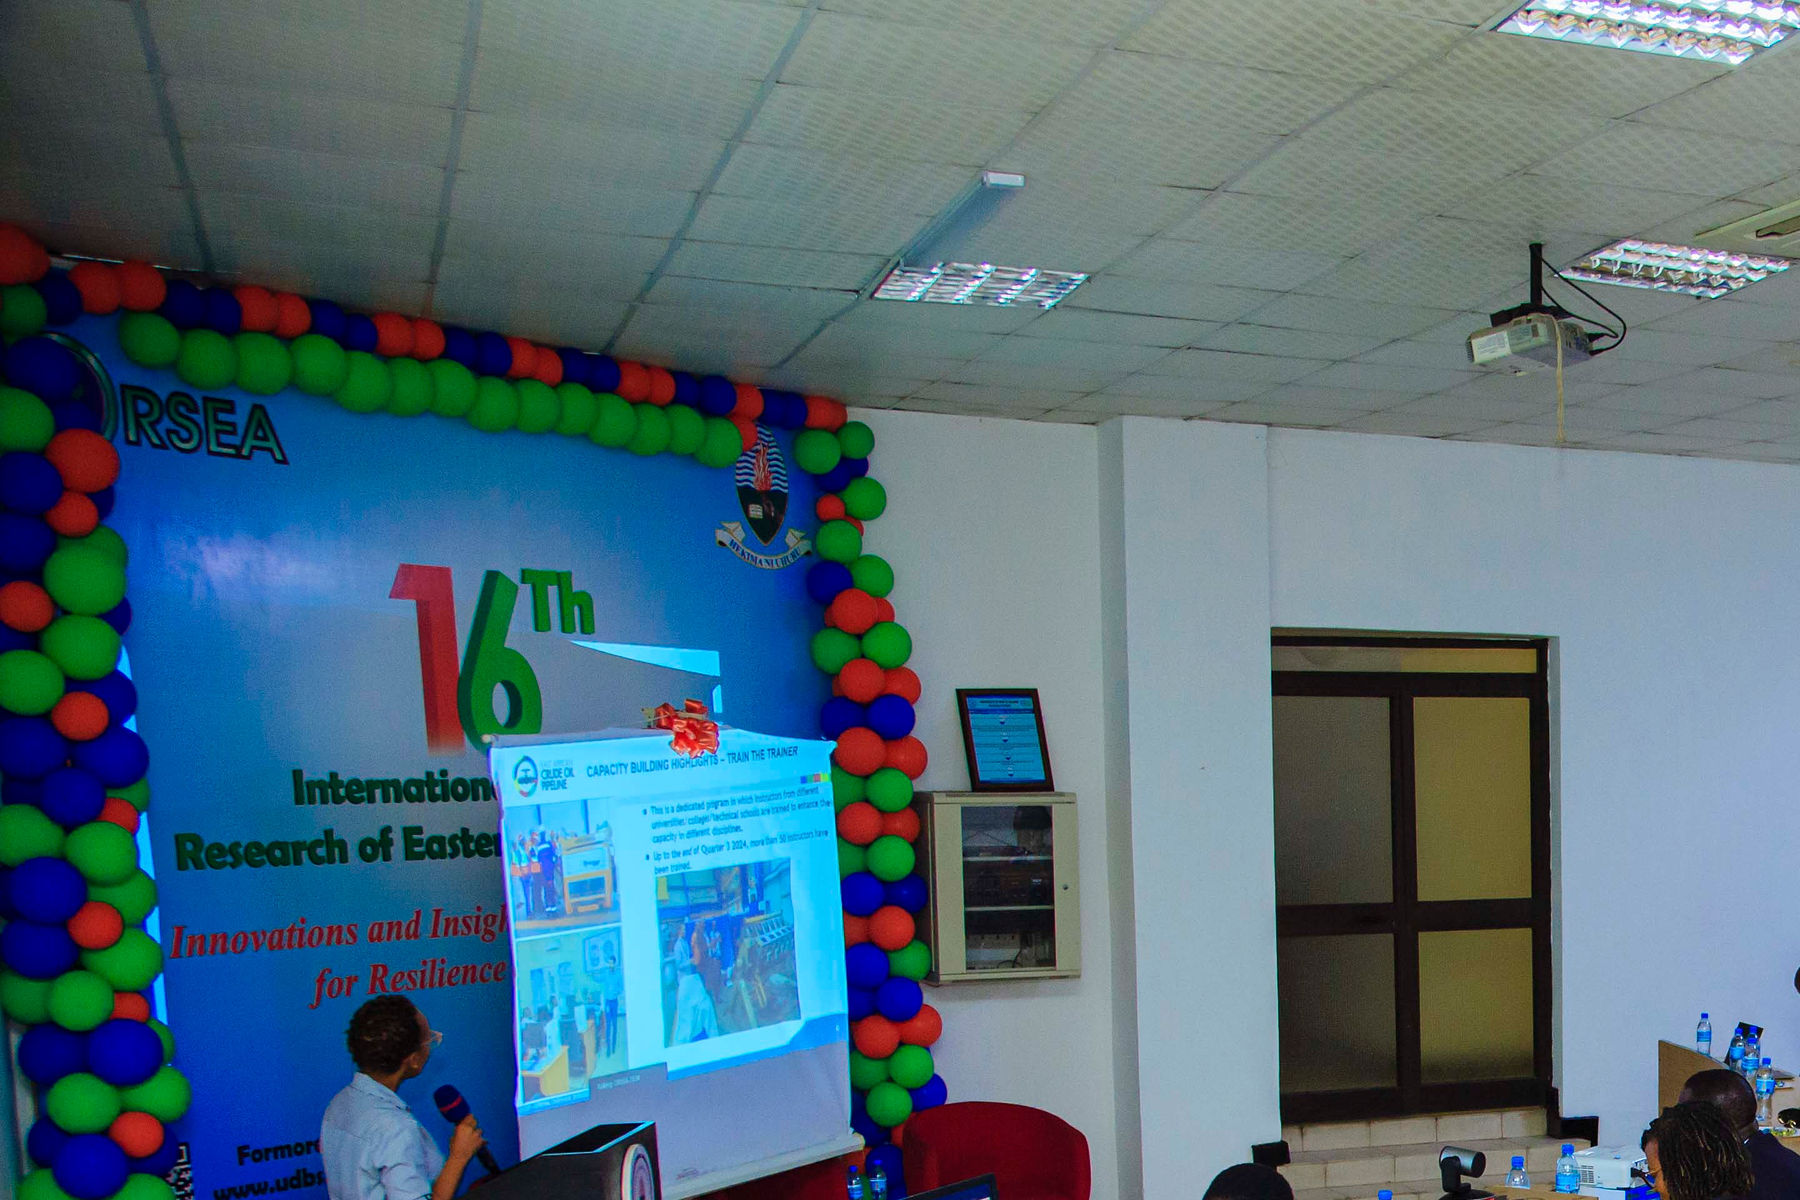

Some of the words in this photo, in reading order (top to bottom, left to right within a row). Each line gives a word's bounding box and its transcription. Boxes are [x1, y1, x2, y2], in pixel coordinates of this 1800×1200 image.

[540, 768, 563, 780] CRUDE
[586, 763, 629, 778] CAPACITY
[631, 759, 669, 773] BUILDING
[671, 754, 719, 769] HIGHLIGHTS
[727, 751, 750, 764] TRAIN
[751, 748, 765, 761] THE
[766, 746, 798, 758] TRAINER
[292, 769, 499, 806] Internation
[541, 779, 567, 791] PIPELINE
[651, 805, 664, 815] This
[676, 801, 705, 812] dedicated
[706, 799, 730, 811] program
[737, 796, 754, 806] which
[783, 789, 796, 801] from
[796, 786, 819, 798] different
[174, 827, 349, 871] Research
[358, 825, 394, 864] of
[652, 832, 677, 844] capacity
[653, 851, 662, 861] Up
[671, 848, 681, 858] the
[701, 842, 724, 856] Quarter
[750, 838, 765, 848] more
[766, 835, 778, 845] than
[815, 828, 829, 839] have
[654, 864, 669, 875] been
[170, 916, 358, 959] Innovations
[368, 909, 422, 944] and
[308, 967, 358, 1010] for
[367, 957, 507, 995] Resilience
